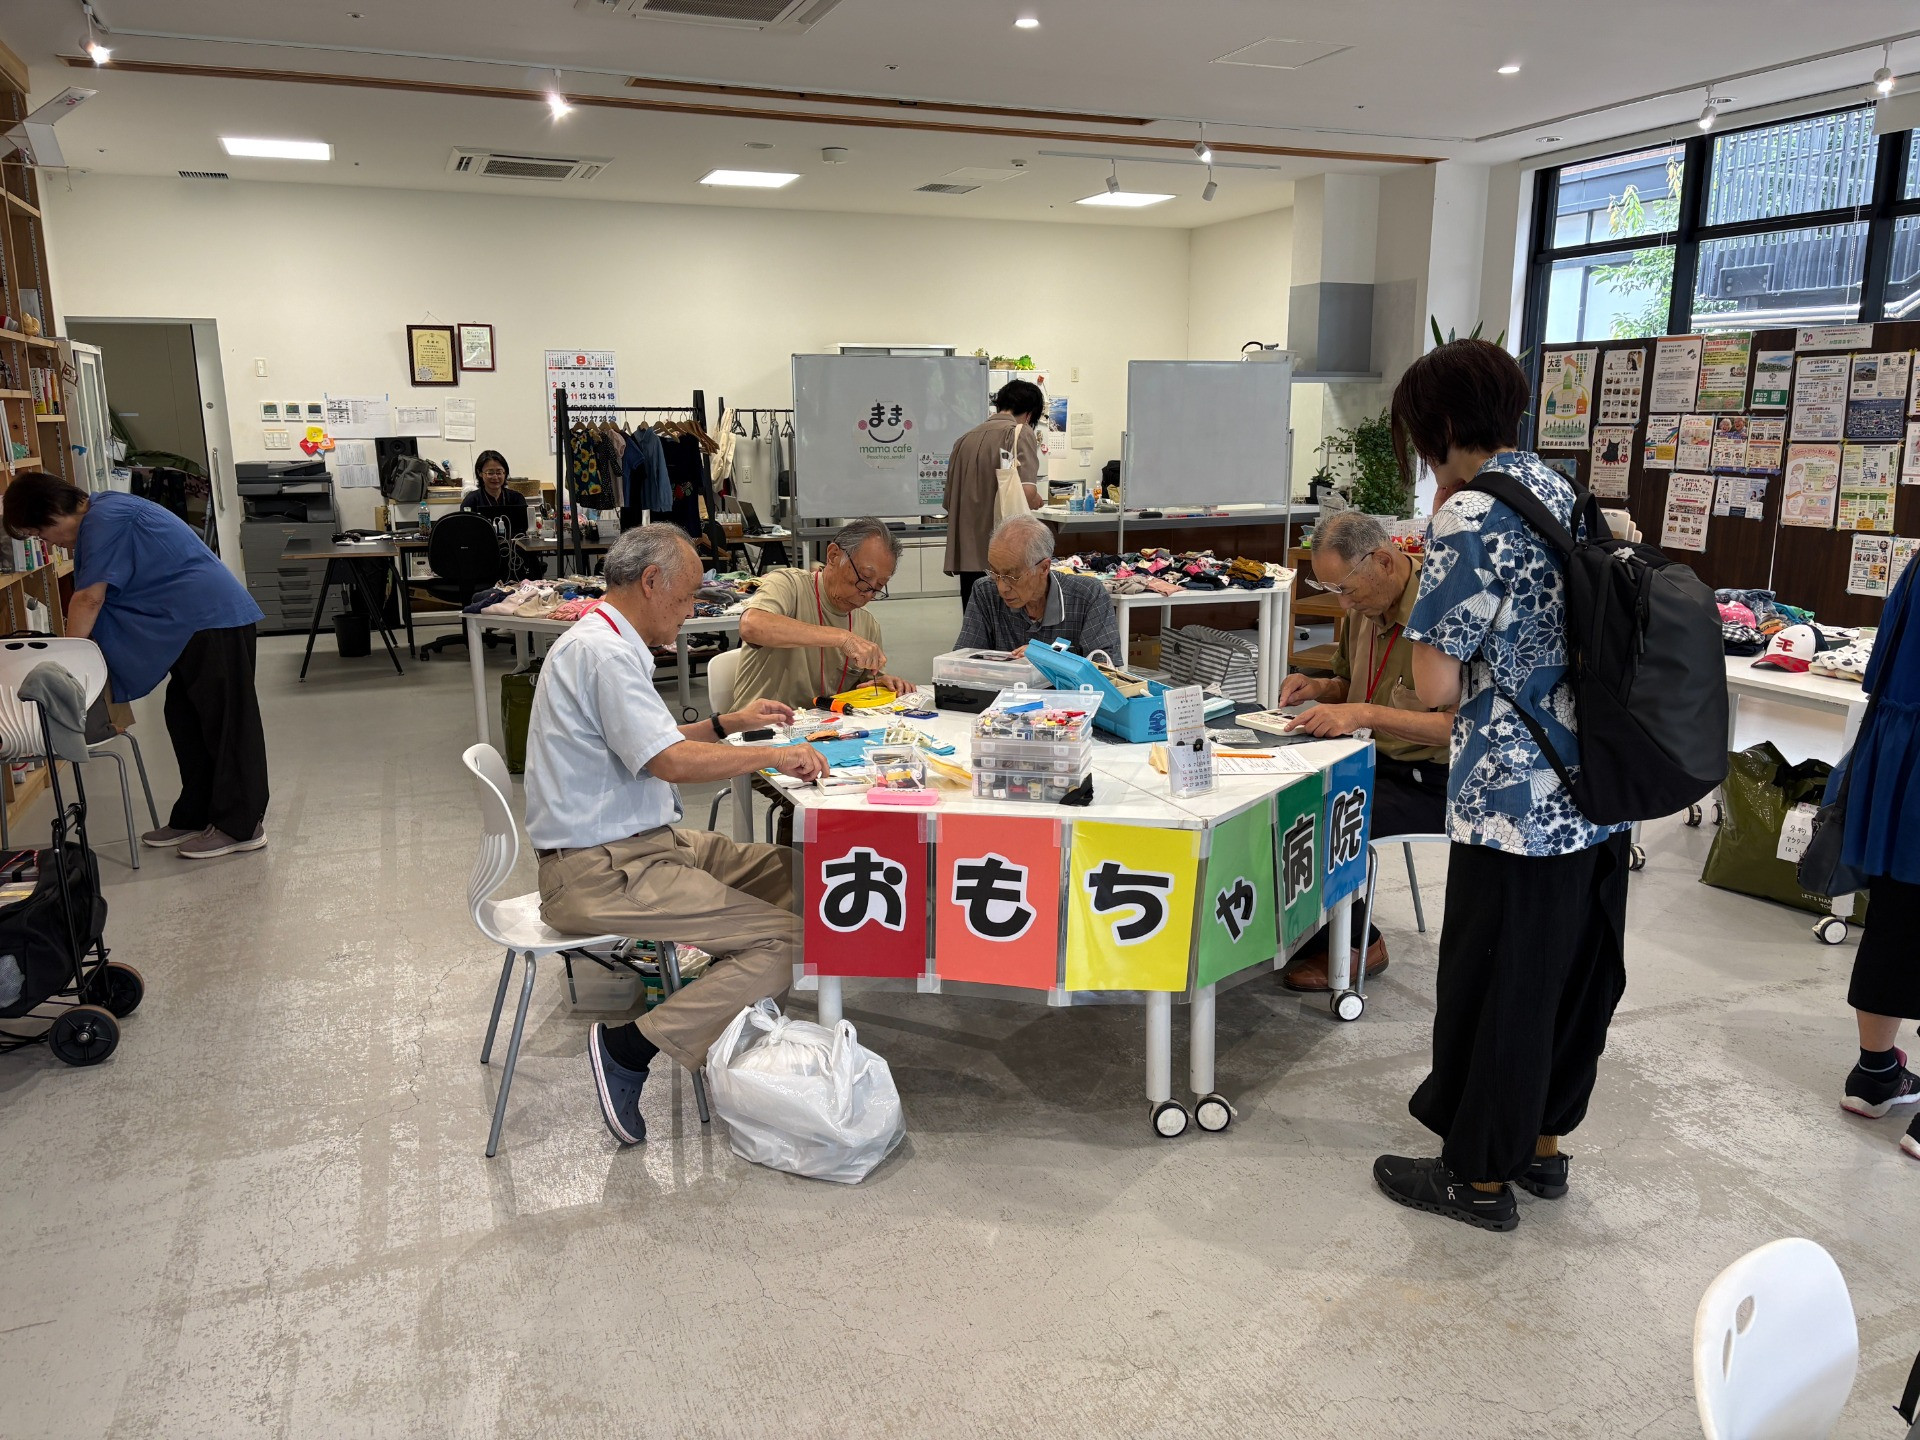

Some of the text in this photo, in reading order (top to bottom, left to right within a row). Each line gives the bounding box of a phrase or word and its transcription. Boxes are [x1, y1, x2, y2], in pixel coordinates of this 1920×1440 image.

[576, 356, 586, 364] 8
[1548, 358, 1561, 368] 大志
[869, 403, 902, 428] まま
[892, 444, 912, 453] cafe
